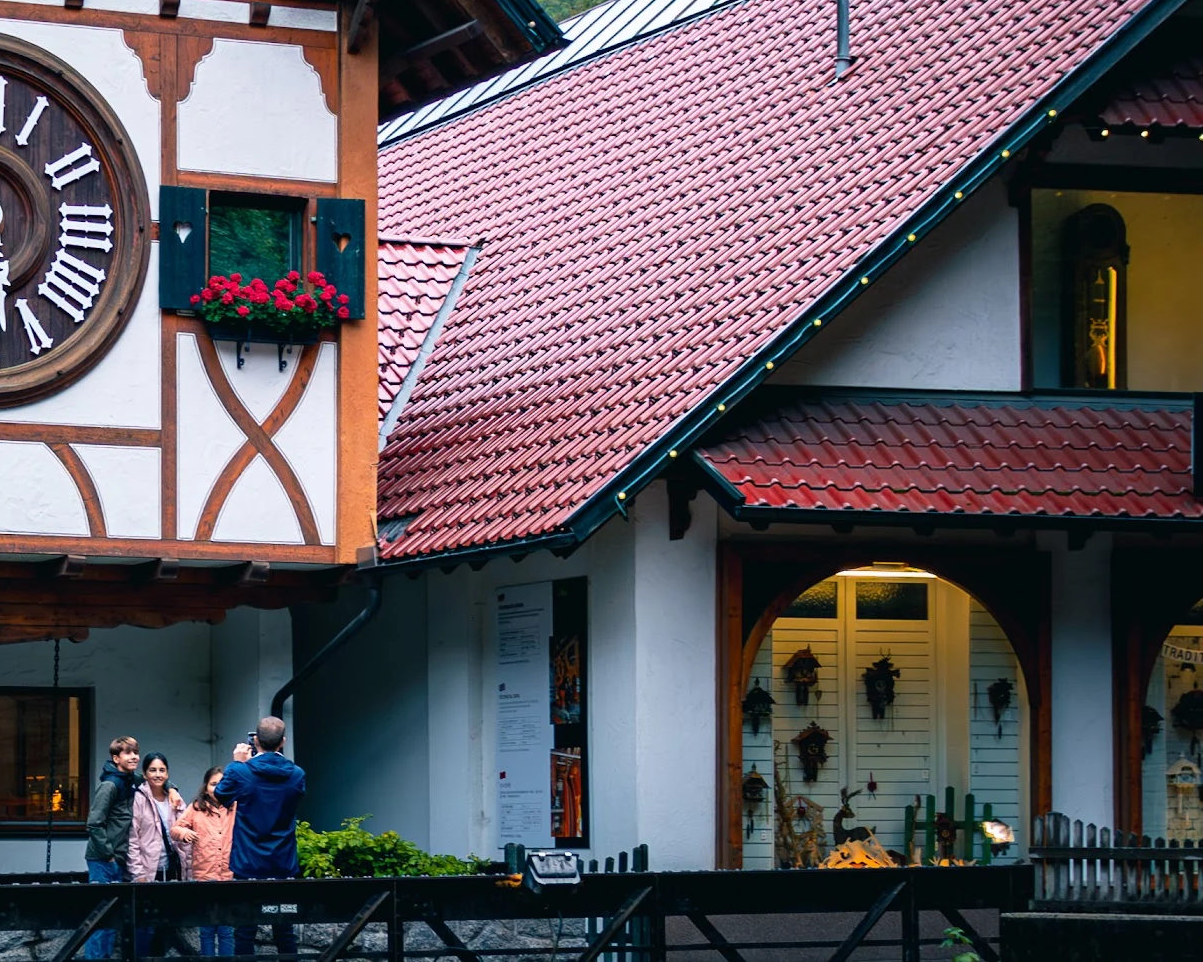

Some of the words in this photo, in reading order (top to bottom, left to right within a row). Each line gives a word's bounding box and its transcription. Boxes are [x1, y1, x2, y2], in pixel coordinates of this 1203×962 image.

[15, 96, 49, 146] I
[45, 142, 100, 190] II
[58, 201, 113, 252] III
[38, 248, 106, 322] IIII
[15, 299, 54, 355] V
